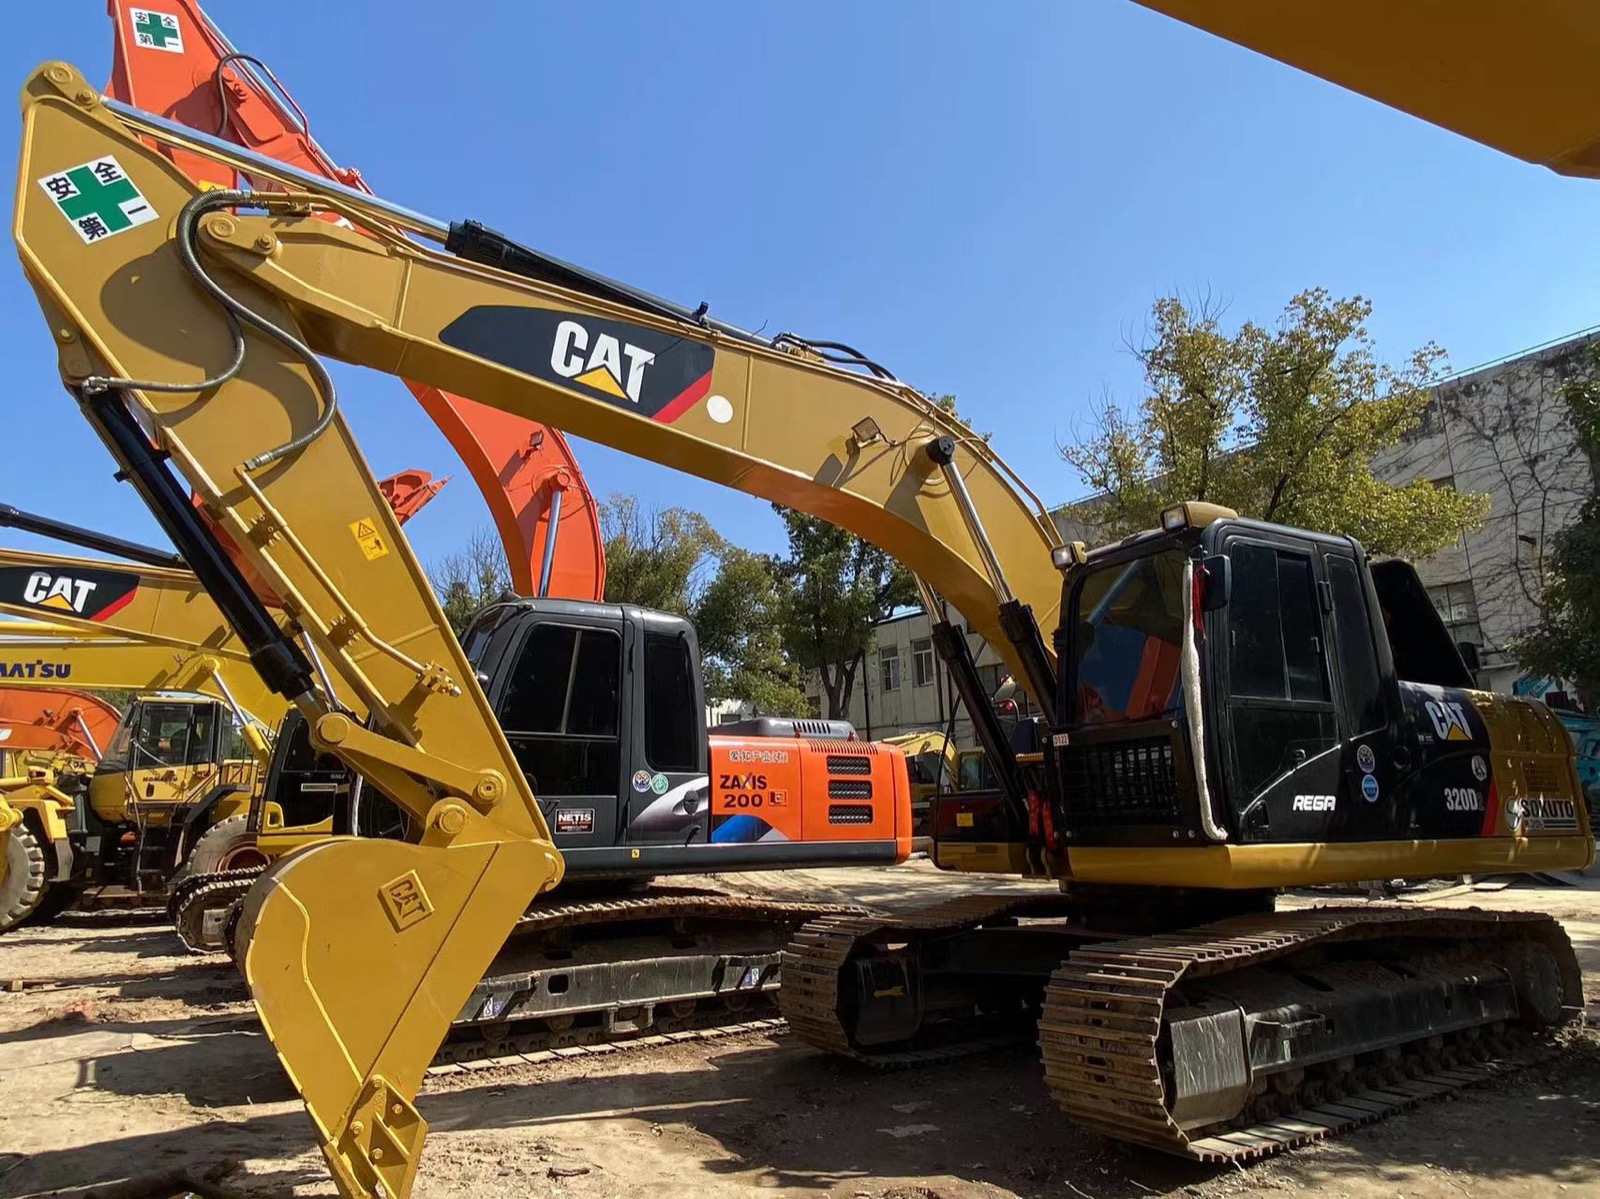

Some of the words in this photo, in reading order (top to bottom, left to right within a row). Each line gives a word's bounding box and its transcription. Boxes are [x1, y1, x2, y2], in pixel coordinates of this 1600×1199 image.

[46, 162, 122, 200] 安全
[78, 205, 147, 240] 第一
[550, 320, 656, 404] CAT
[23, 571, 97, 613] CAT
[1424, 700, 1473, 740] CAT
[720, 772, 767, 790] ZAXIS
[558, 813, 592, 822] NETIS
[723, 793, 763, 808] 200
[1292, 794, 1337, 811] REGA
[1520, 799, 1574, 818] SOKUTO
[389, 879, 426, 919] CAT
